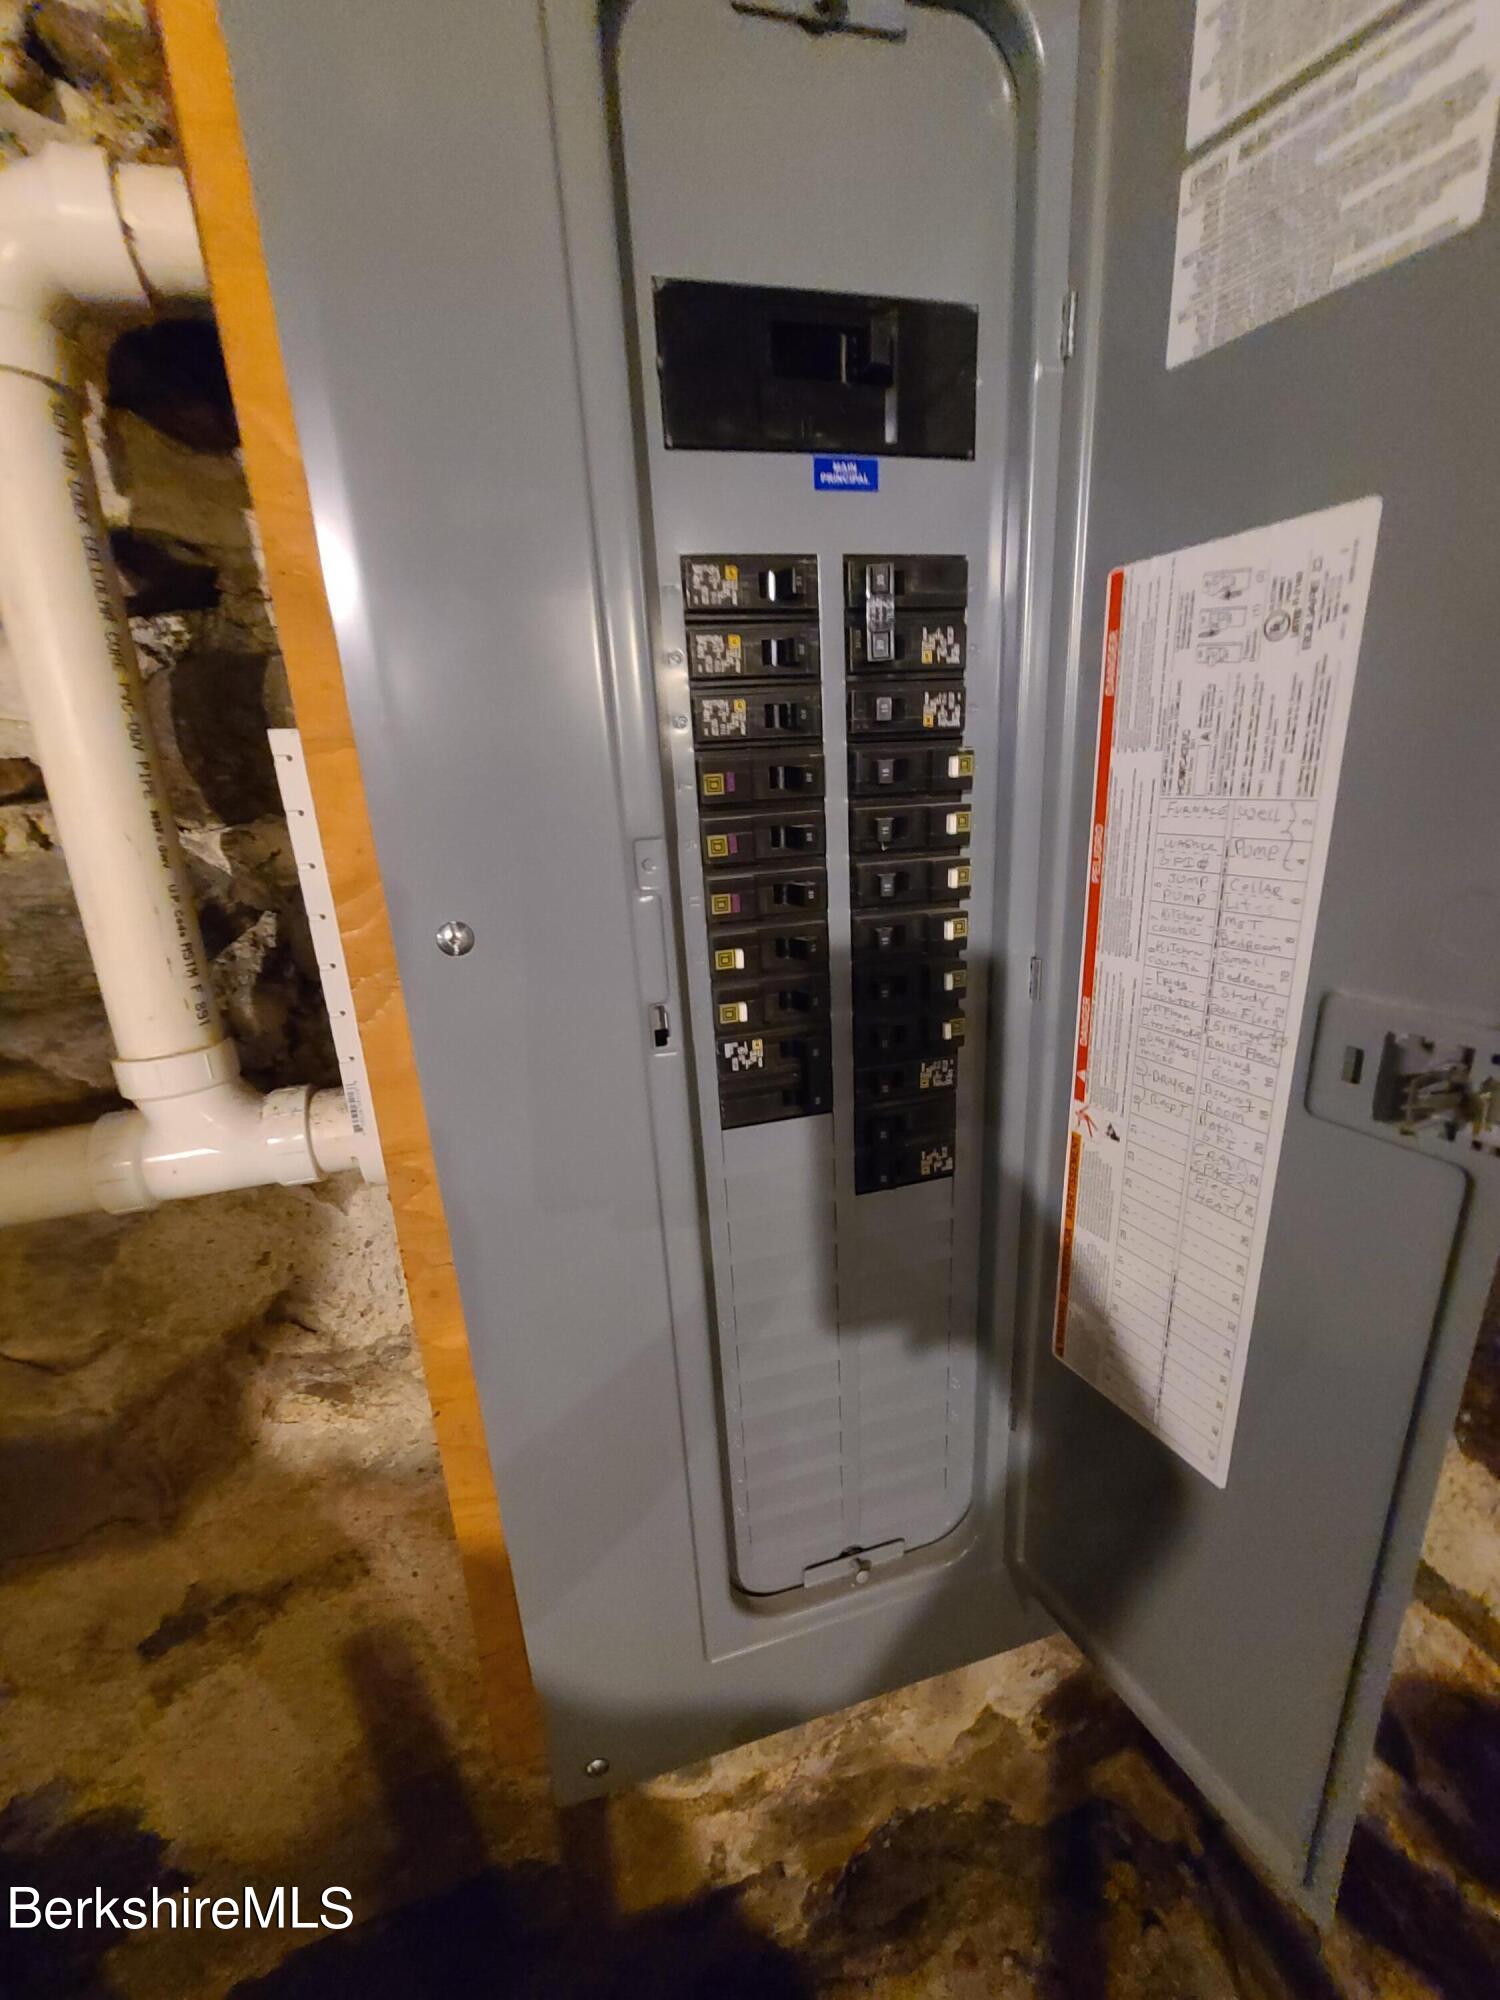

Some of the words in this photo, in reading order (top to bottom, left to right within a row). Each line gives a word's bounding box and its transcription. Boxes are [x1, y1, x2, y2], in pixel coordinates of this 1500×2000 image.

[832, 461, 858, 473] MAIN
[820, 471, 871, 486] PRINCIPAL
[179, 942, 199, 979] ASTM
[195, 1001, 211, 1026] 891
